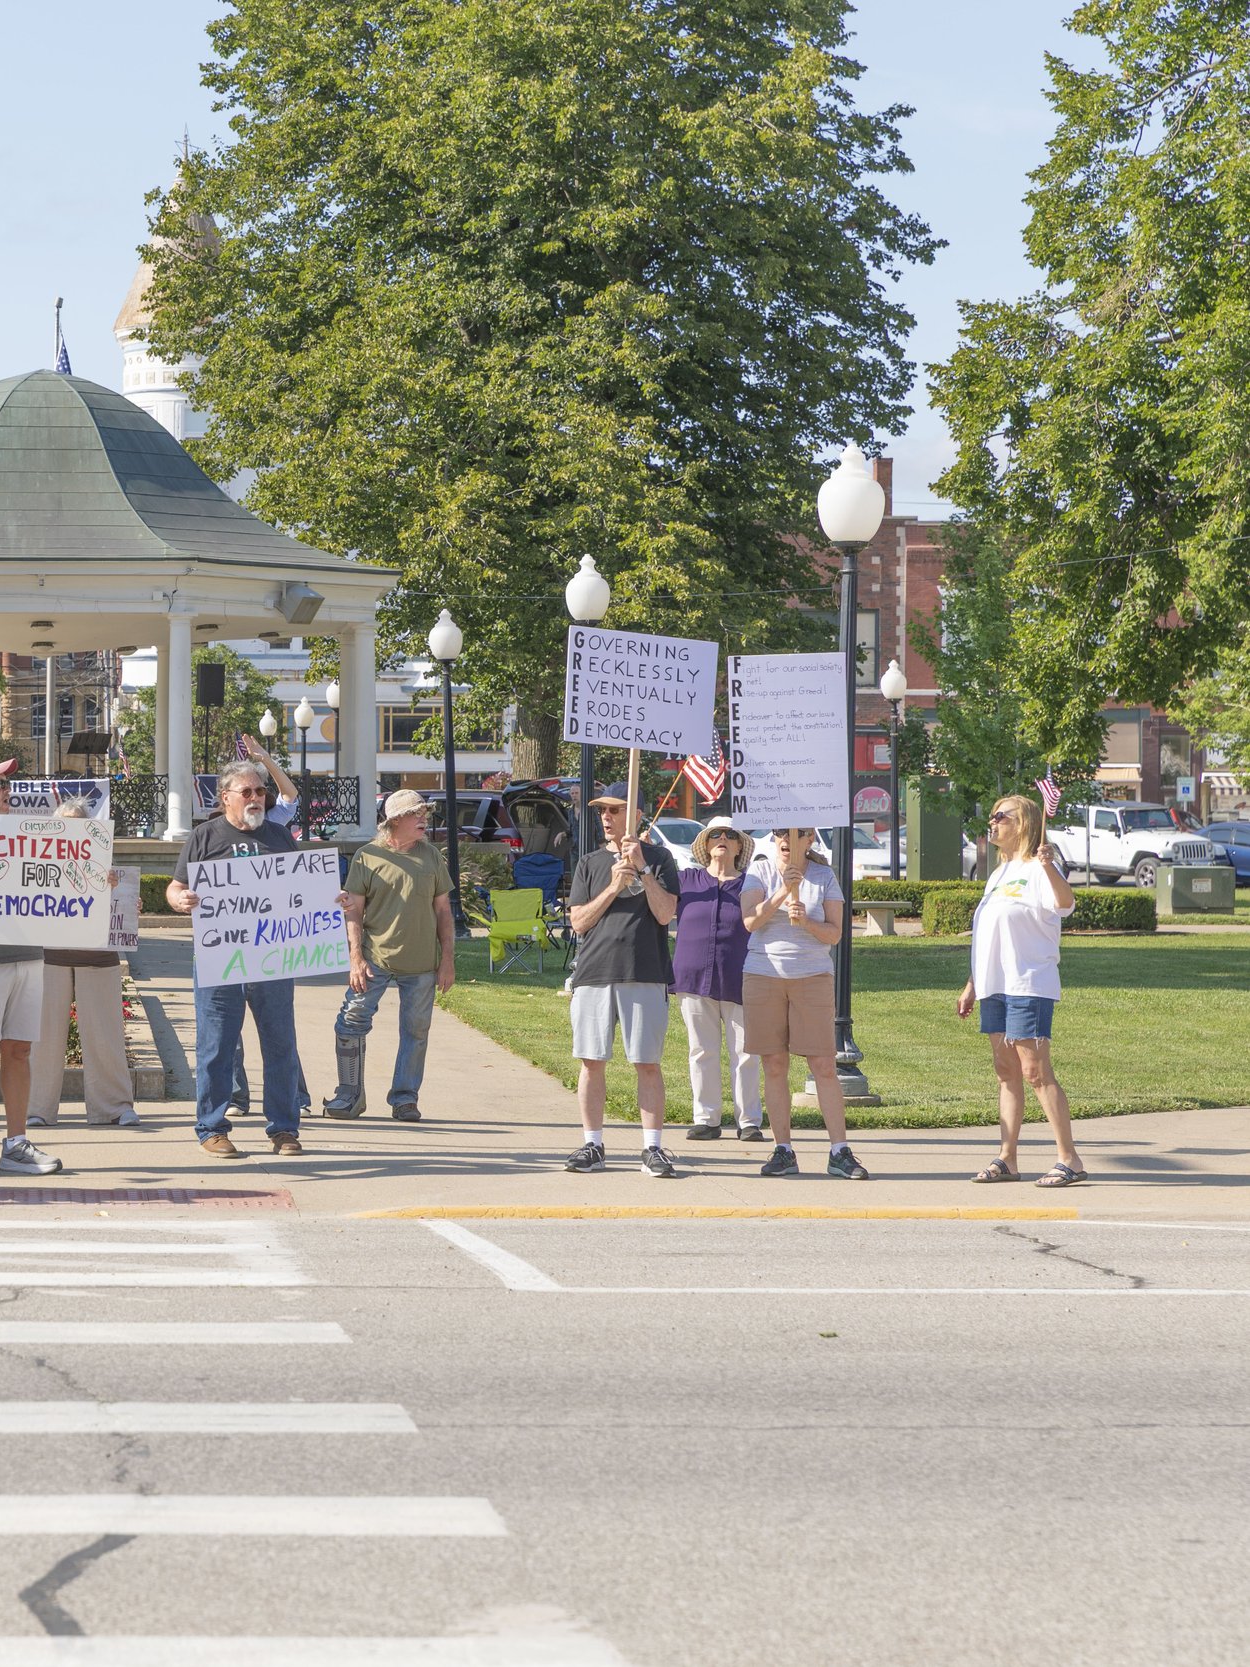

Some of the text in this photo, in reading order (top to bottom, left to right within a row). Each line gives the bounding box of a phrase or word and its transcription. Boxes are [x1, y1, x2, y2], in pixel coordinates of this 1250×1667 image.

[574, 631, 689, 660] GOVERNING
[573, 652, 700, 684] RECKLESSLY
[766, 662, 780, 673] for
[782, 664, 796, 672] our
[573, 674, 696, 706] EVENTUALLY
[572, 696, 646, 721] ERODES
[776, 712, 784, 720] to
[570, 718, 682, 746] DEMOCRACY
[770, 734, 783, 743] for
[791, 722, 802, 730] the
[9, 796, 50, 807] OWA
[22, 862, 62, 888] FOR
[192, 853, 336, 891] ALL WE ARE
[200, 893, 303, 919] SAYING IS
[202, 910, 342, 948] GIVE KINDNESS
[222, 941, 349, 981] A CHANCE
